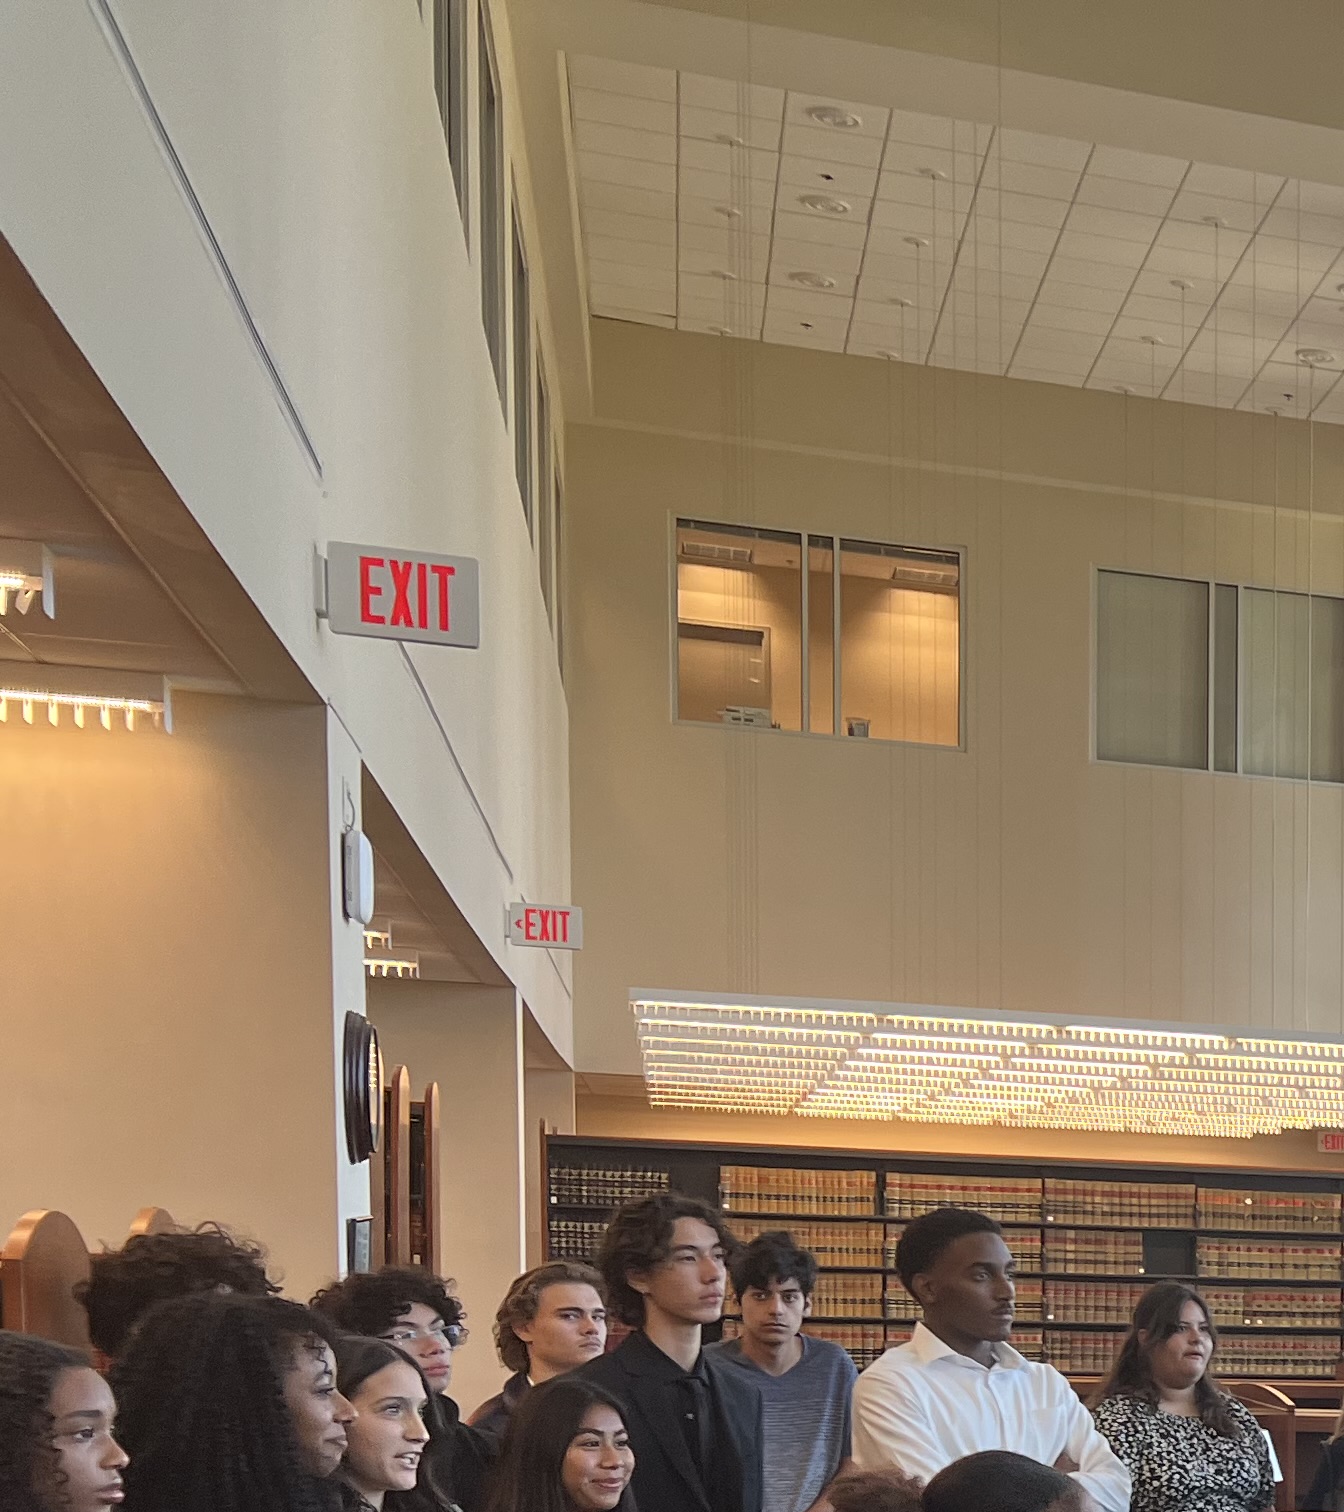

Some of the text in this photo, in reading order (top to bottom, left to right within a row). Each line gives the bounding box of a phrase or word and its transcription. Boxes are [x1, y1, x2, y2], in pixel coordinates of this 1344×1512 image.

[359, 555, 456, 632] EXIT
[524, 907, 570, 944] EXIT
[1324, 1133, 1344, 1150] EXIT
